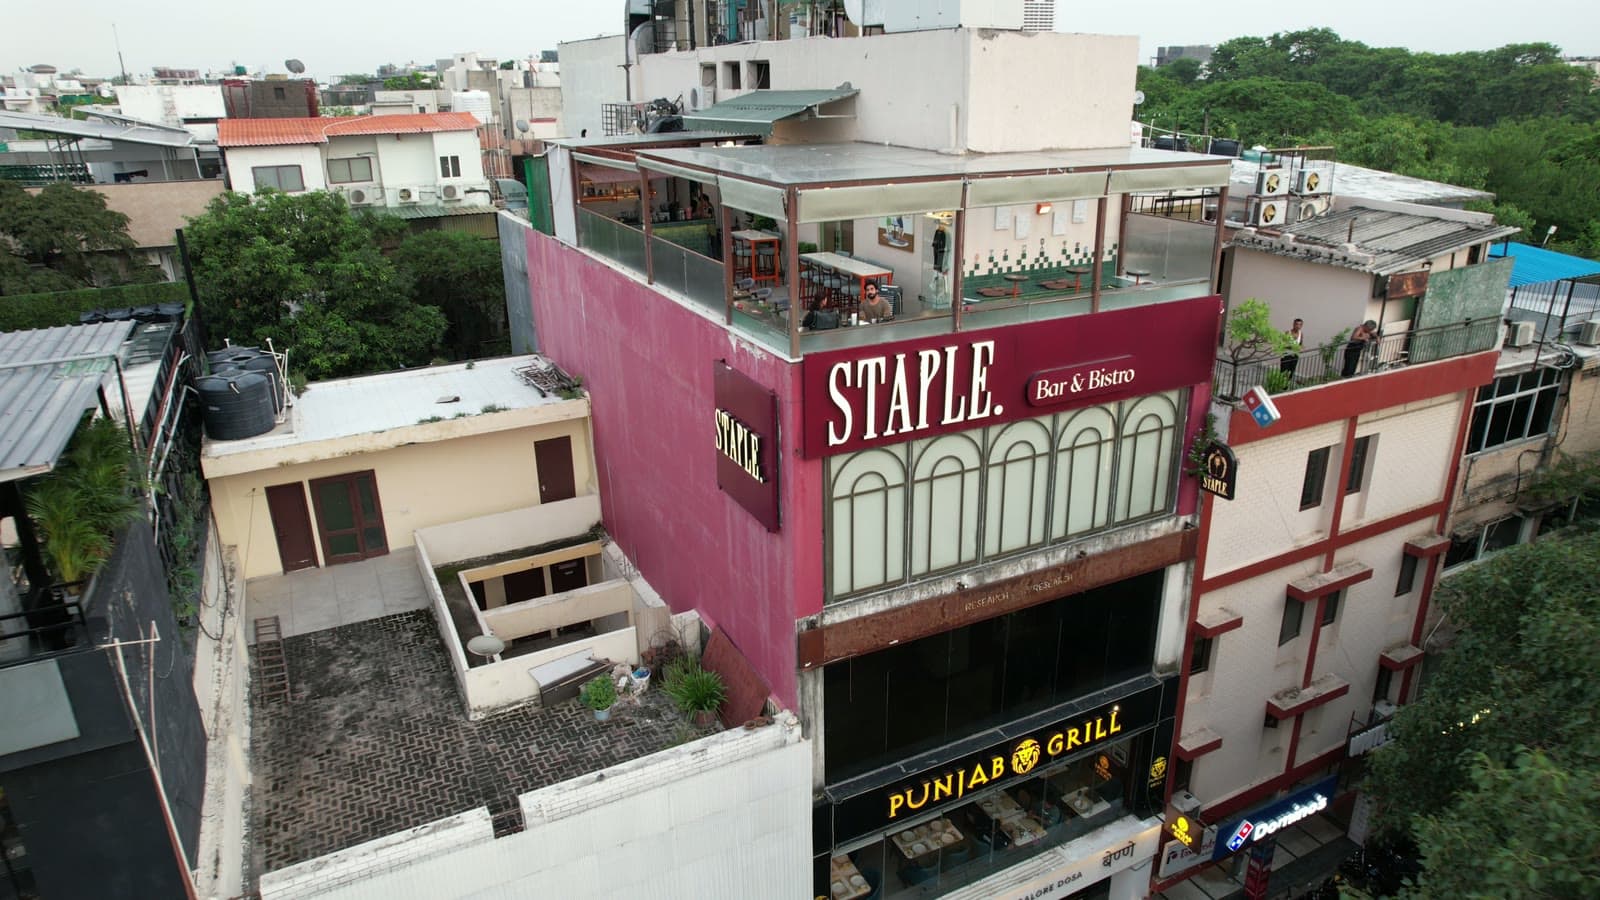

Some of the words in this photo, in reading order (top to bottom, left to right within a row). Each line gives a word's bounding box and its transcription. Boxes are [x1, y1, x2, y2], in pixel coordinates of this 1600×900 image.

[828, 340, 1003, 447] STAPLE.
[1035, 379, 1067, 400] Bar
[1069, 373, 1084, 392] &
[1088, 367, 1135, 390] Bistro
[715, 408, 763, 484] STAPLE.
[965, 592, 1009, 611] RESEARCH
[889, 756, 1005, 818] PUNJAB
[1047, 711, 1121, 756] GRILL
[1252, 793, 1328, 841] Domino's
[1018, 883, 1054, 900] ALORE
[1057, 871, 1083, 888] DOSA
